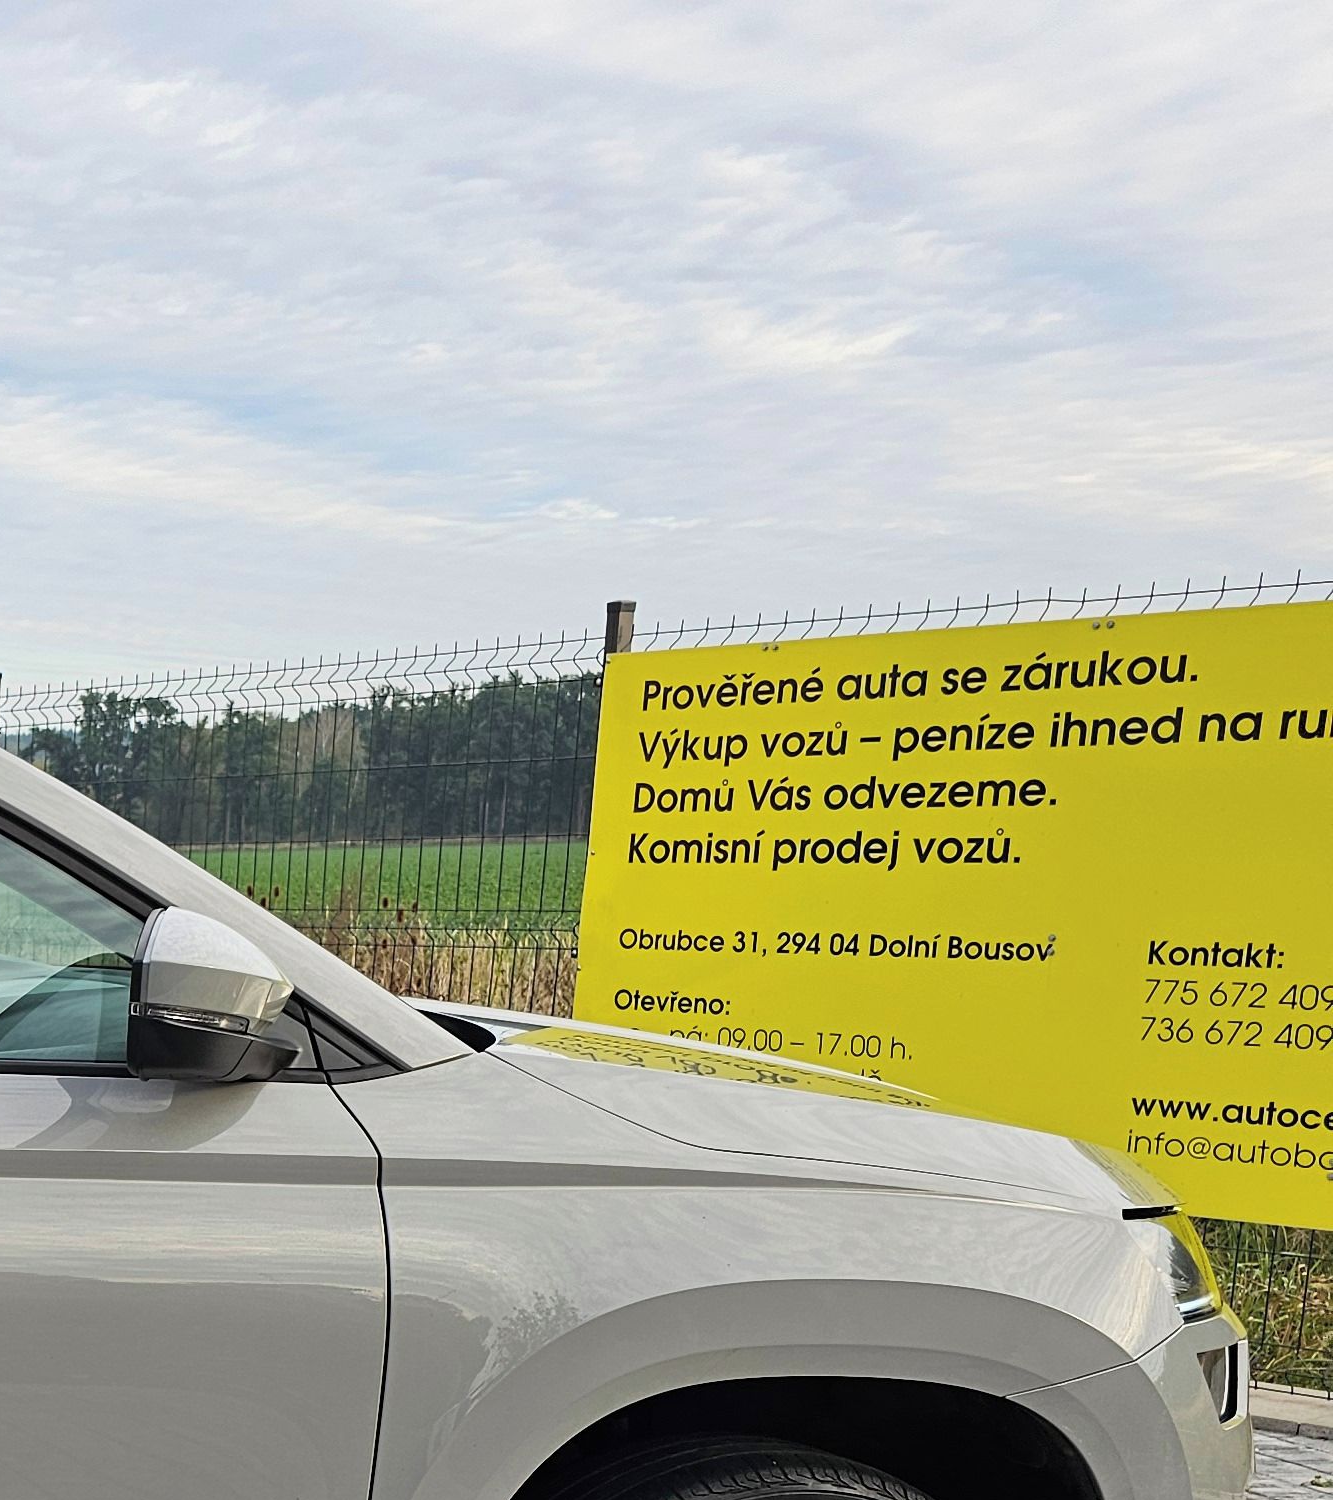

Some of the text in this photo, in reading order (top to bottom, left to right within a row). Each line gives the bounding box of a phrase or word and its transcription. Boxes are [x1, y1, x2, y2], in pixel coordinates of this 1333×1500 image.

[642, 649, 1198, 712] Prověřené auta se zárukou.
[638, 727, 748, 770] Výkup
[760, 721, 848, 758] vozů
[892, 712, 1035, 761] peníze
[1049, 706, 1184, 748] ihned
[1198, 711, 1264, 743] na
[1278, 708, 1333, 740] ru
[632, 775, 1057, 814] Domů Vás odvezeme.
[628, 827, 1021, 872] Komisní prodej vozů.
[619, 928, 1056, 962] Obrubce 31, 294 04 Dolní Bousov
[1147, 940, 1285, 969] Kontakt:
[614, 988, 731, 1016] Otevřeno:
[1145, 978, 1333, 1012] 775 672 409
[816, 1032, 882, 1059] 17.00
[890, 1036, 912, 1061] h.
[1140, 1016, 1333, 1051] 736 672 409
